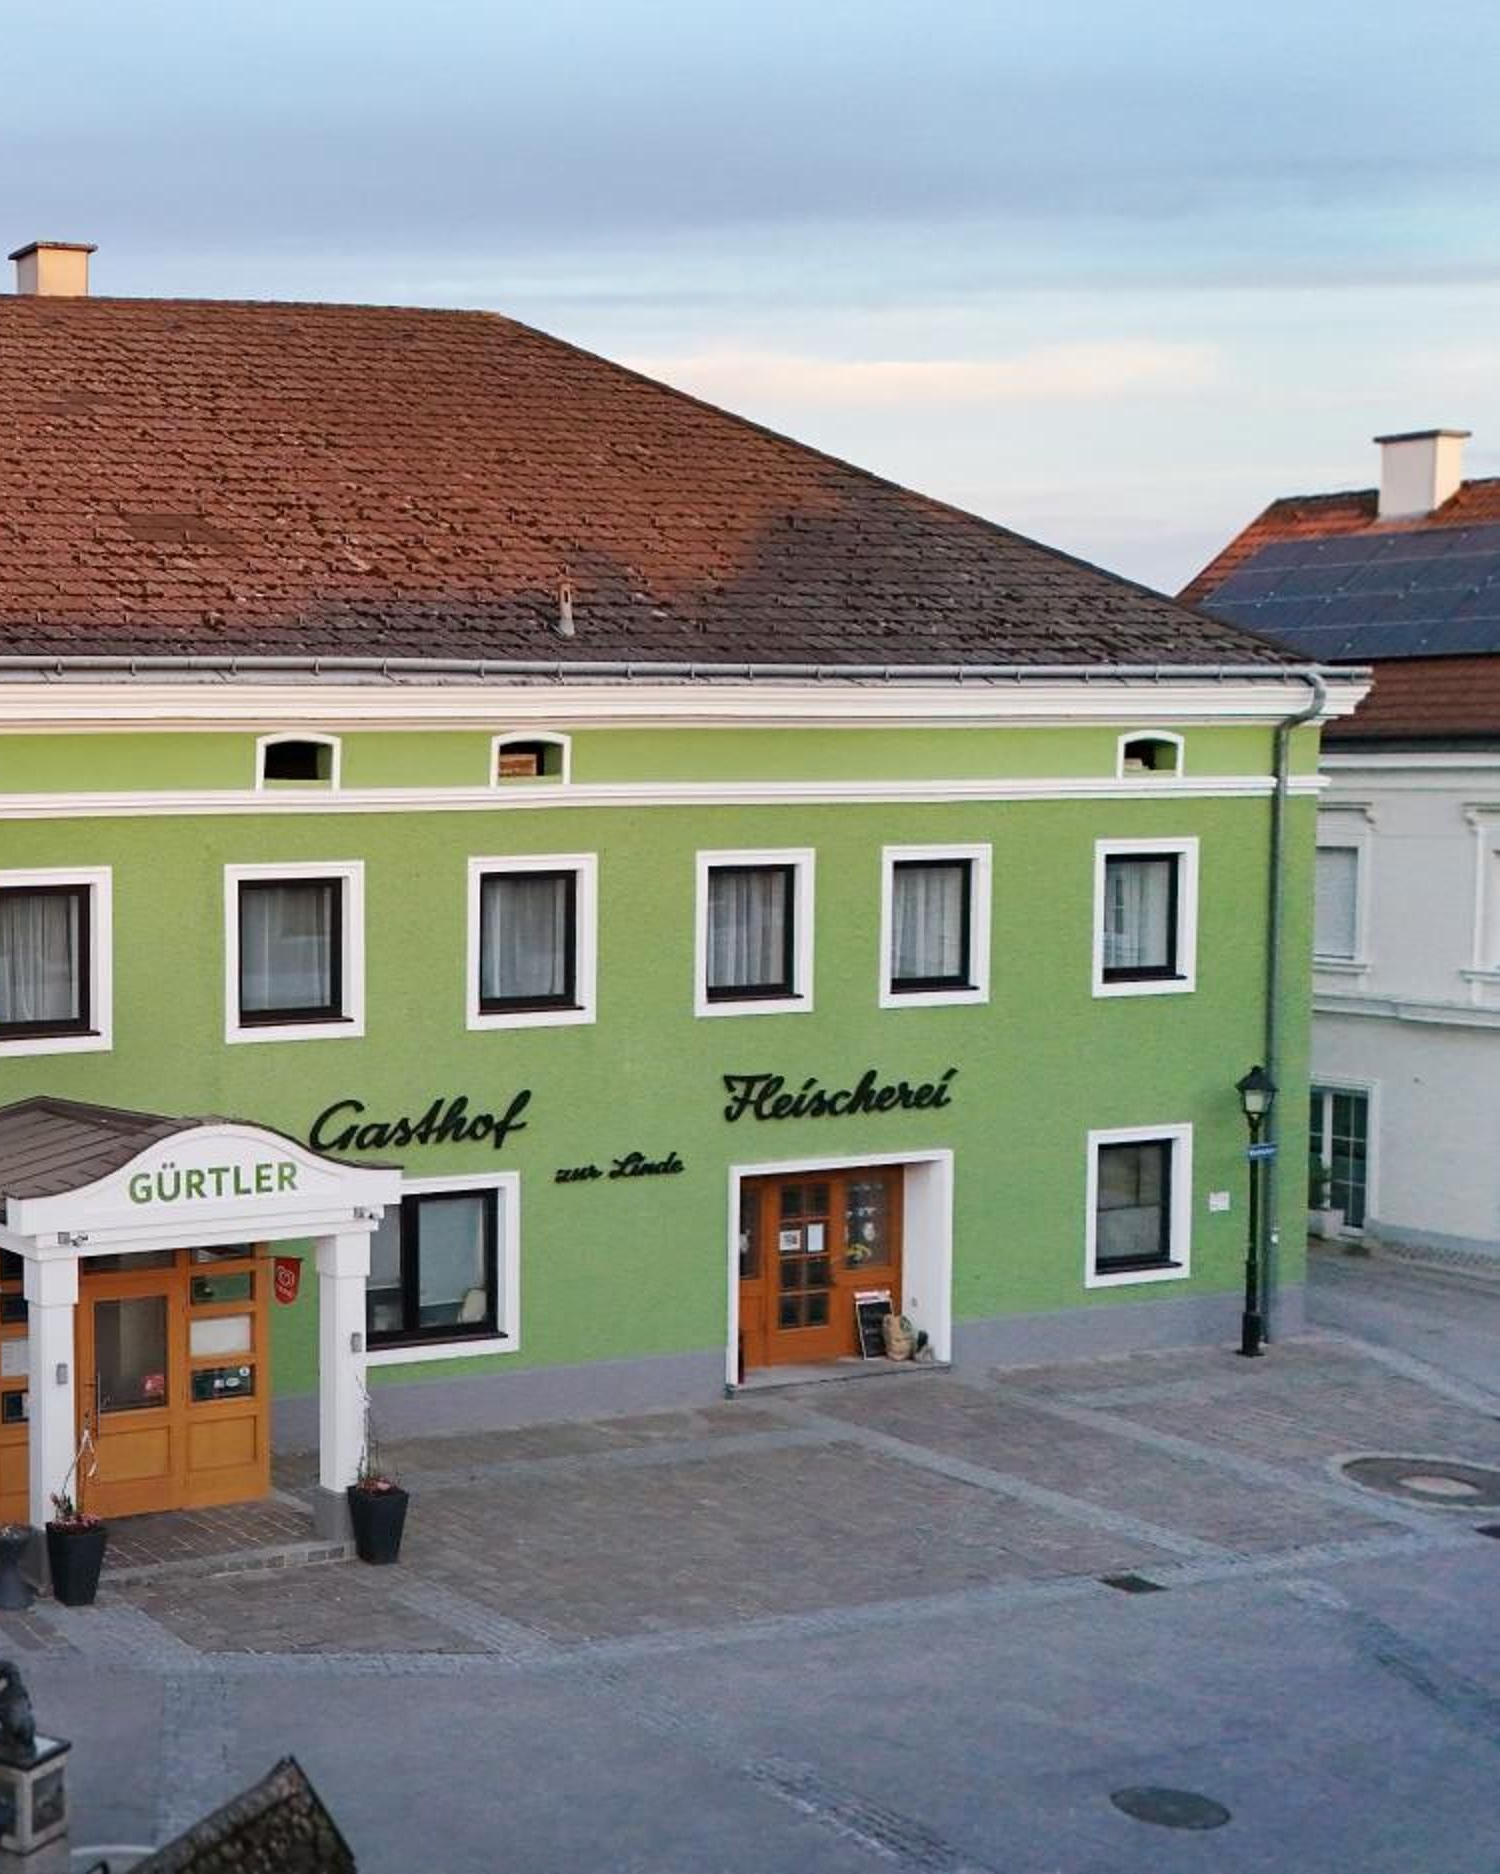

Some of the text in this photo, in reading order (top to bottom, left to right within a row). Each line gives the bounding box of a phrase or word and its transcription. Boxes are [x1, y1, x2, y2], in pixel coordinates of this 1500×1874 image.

[723, 1067, 959, 1122] Fleischerei
[309, 1089, 532, 1151] Gasthof
[128, 1161, 299, 1204] GÜRTLER
[554, 1151, 686, 1184] zur Linde
